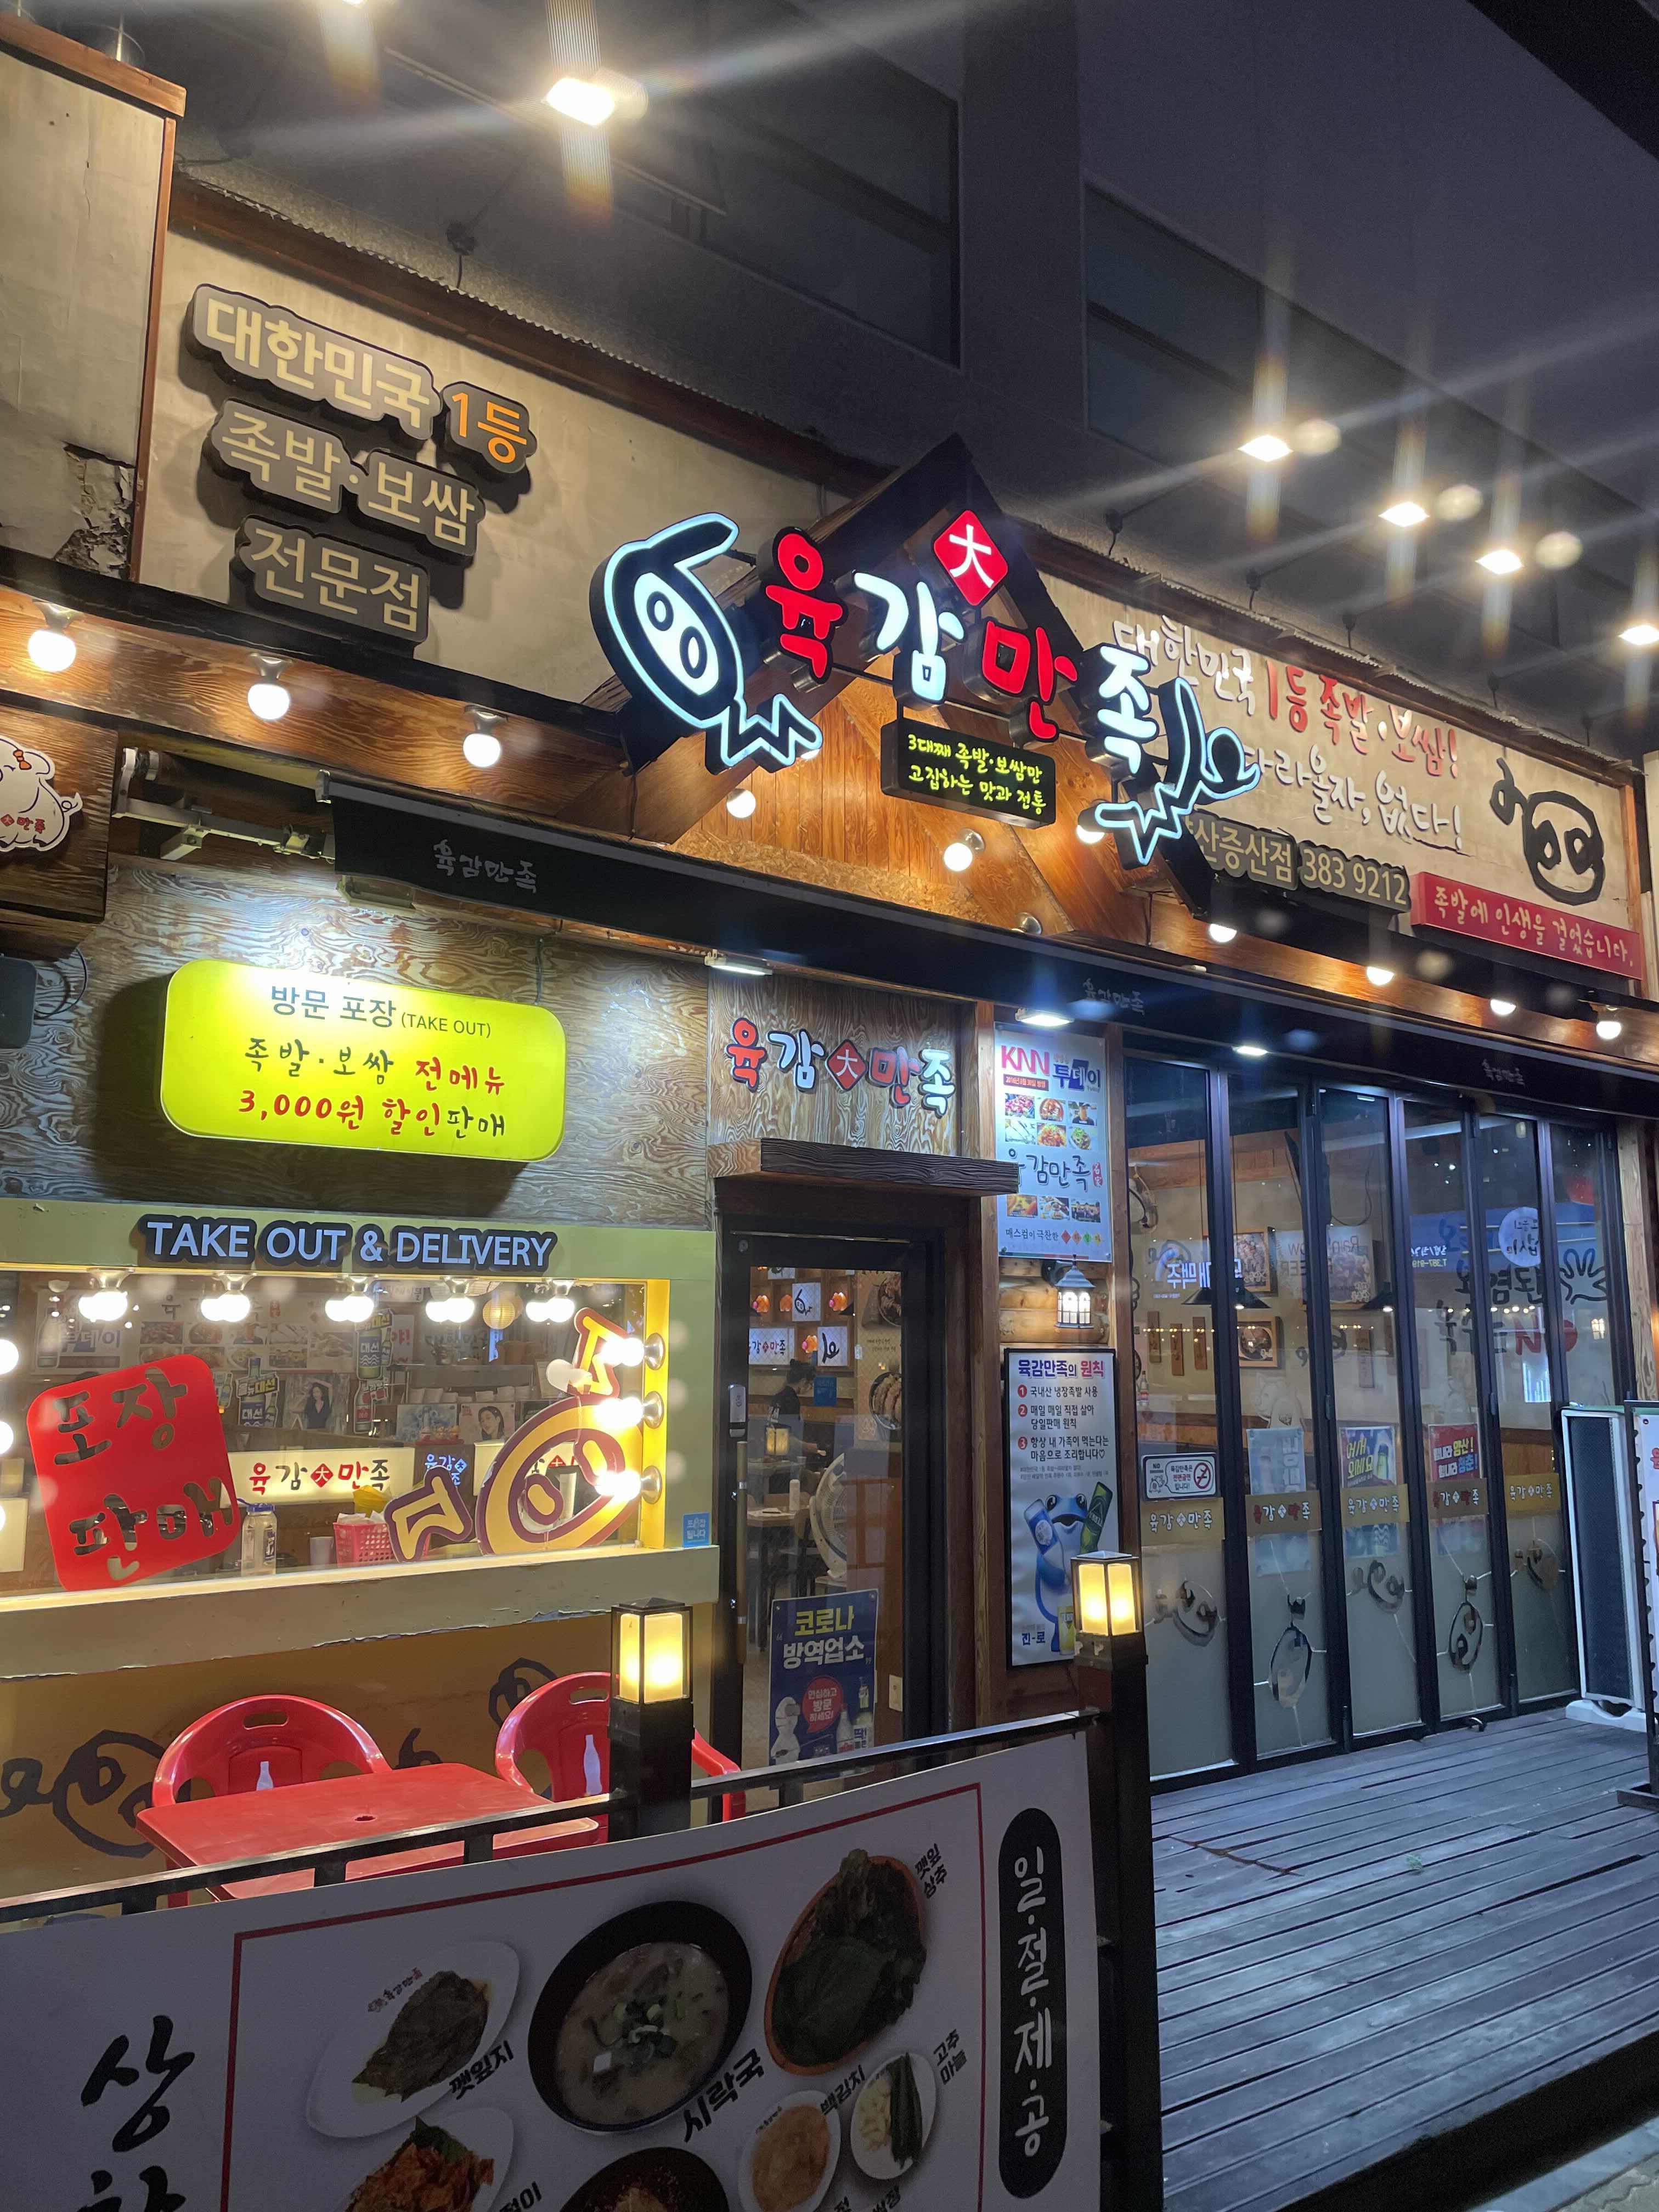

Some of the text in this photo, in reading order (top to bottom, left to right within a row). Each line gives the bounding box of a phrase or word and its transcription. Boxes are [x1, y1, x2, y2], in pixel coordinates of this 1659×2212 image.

[206, 298, 528, 464] 대한민국 1등
[222, 411, 476, 546] 족발·보쌈
[251, 527, 420, 633] 전문점
[1113, 614, 1256, 716] 대한민국
[909, 734, 1043, 785] 3대째 족발·보쌈만
[909, 765, 1047, 815] 고집하는 맛과 전통
[1375, 770, 1462, 850] 없다!
[1302, 848, 1346, 889] 383
[1352, 862, 1407, 905] 9212
[1434, 886, 1634, 967] 족발에 인생을 걸었습니다.
[270, 985, 492, 1039] 방문 포장 (TAKE OUT)
[415, 1056, 505, 1096] 전메뉴
[1001, 1045, 1050, 1076] KNN
[1052, 1062, 1101, 1090] 투데이
[238, 1090, 505, 1138] 3,000원 할인판매
[146, 1221, 554, 1266] TAKE OUT & DELIVERY
[1005, 1227, 1035, 1240] 매스컴이
[1036, 1229, 1059, 1241] 극찬한
[1018, 1359, 1105, 1378] 육감만족의 원칙
[1030, 1386, 1052, 1398] 국내산
[1054, 1386, 1082, 1398] 냉장족발
[1084, 1386, 1098, 1398] 사용
[1030, 1405, 1046, 1416] 매일
[1047, 1405, 1063, 1416] 매일
[1064, 1405, 1078, 1416] 직접
[1080, 1404, 1094, 1416] 삶아
[54, 1367, 189, 1466] 포장
[241, 1408, 263, 1420] 대선
[1031, 1418, 1077, 1430] 당일판매 원칙
[1030, 1436, 1047, 1448] 항상
[1049, 1436, 1057, 1448] 내
[1059, 1436, 1080, 1448] 가족이
[1081, 1435, 1109, 1447] 먹는다는
[1030, 1450, 1062, 1462] 마음으로
[69, 1476, 235, 1581] 판매
[794, 1605, 855, 1637] 코로나
[783, 1635, 865, 1669] 방역업소
[808, 1688, 837, 1700] 안심하고
[812, 1700, 832, 1713] 방문
[914, 1843, 941, 1881] 깻잎
[923, 1865, 948, 1899] 상추
[933, 2029, 961, 2067] 고추
[940, 2049, 968, 2085] 마늘
[448, 2040, 515, 2101] 깻잎지
[820, 2064, 866, 2116] 백김치
[683, 2048, 765, 2143] 시락국
